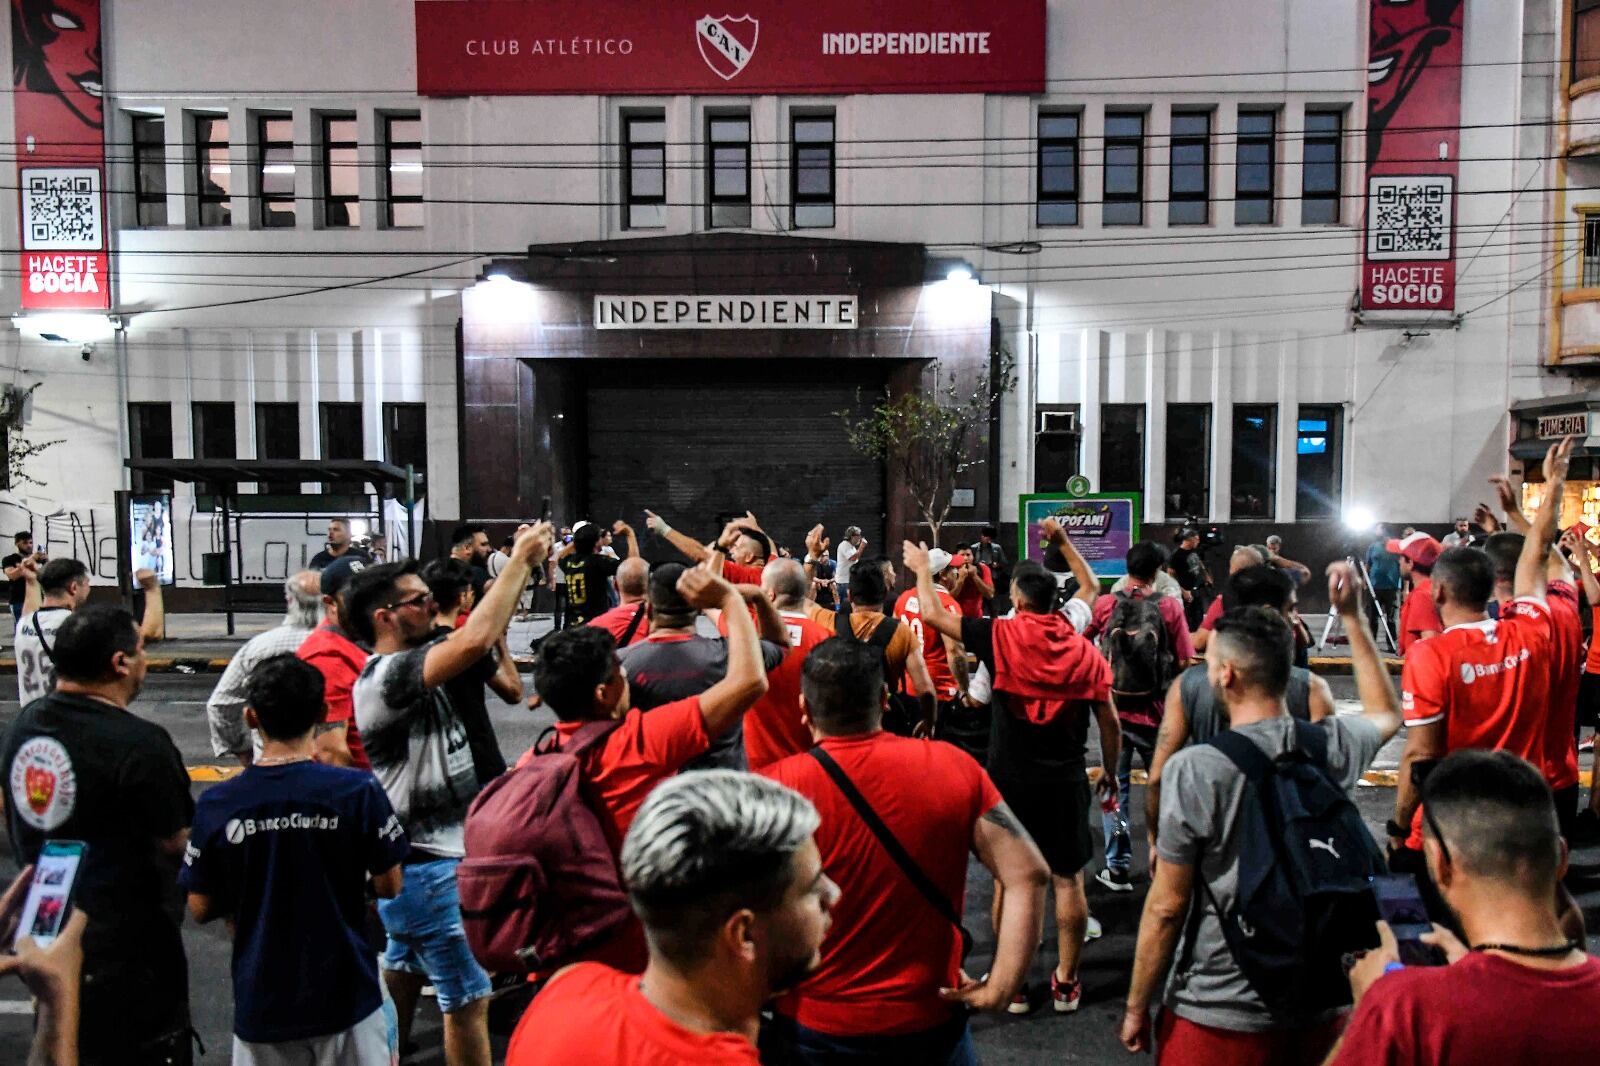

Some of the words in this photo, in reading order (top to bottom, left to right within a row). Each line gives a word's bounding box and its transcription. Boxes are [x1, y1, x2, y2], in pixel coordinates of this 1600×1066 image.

[466, 40, 520, 55] CLUB
[531, 36, 633, 55] ATLÉTICO
[822, 32, 991, 54] INDEPENDIENTE
[29, 255, 99, 273] HACETE
[29, 272, 100, 293] SOCIA
[1371, 267, 1445, 284] HACETE
[1371, 284, 1443, 304] SOCIO
[599, 300, 853, 323] INDEPENDIENTE
[1047, 514, 1104, 528] XPOFAN!
[245, 812, 339, 836] BancoCiudad
